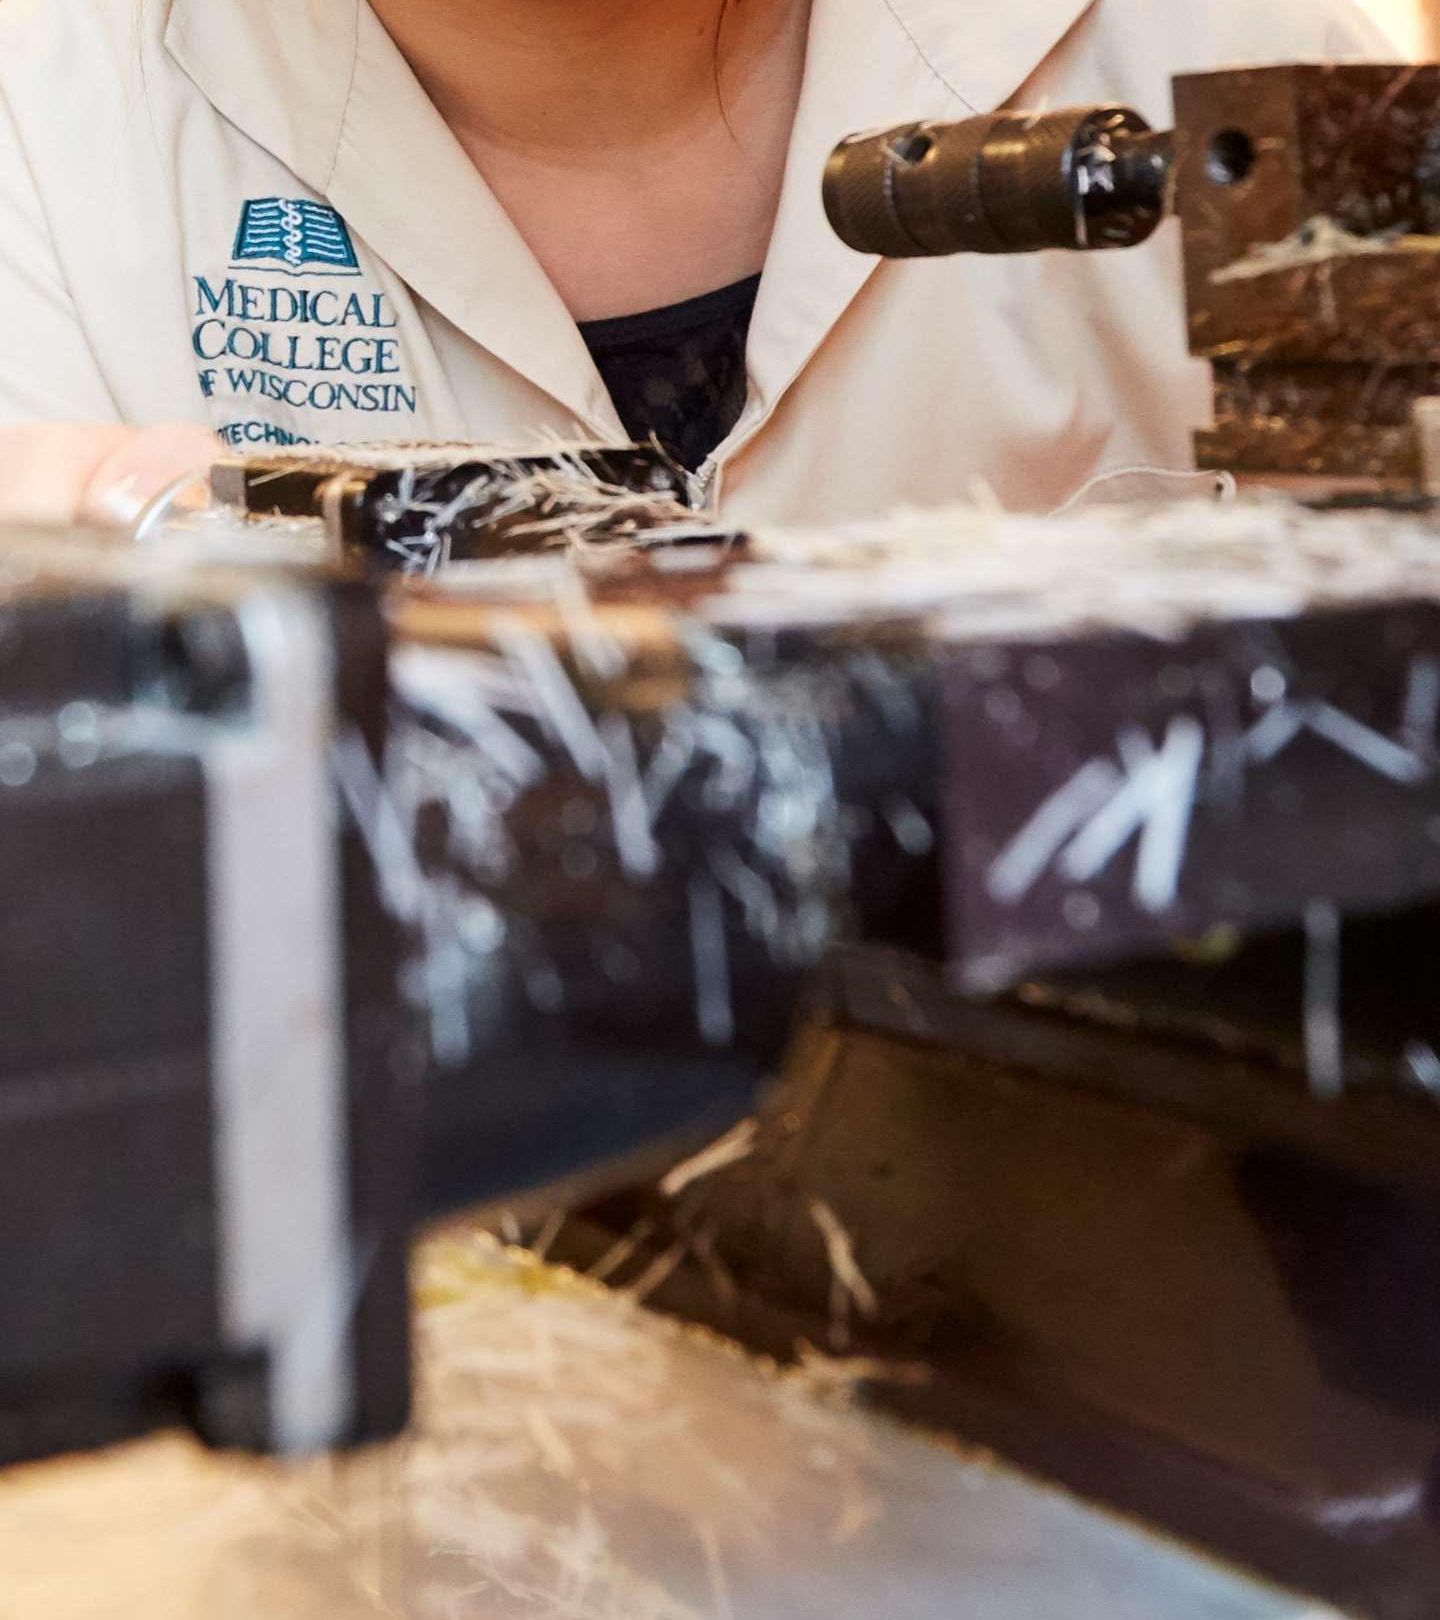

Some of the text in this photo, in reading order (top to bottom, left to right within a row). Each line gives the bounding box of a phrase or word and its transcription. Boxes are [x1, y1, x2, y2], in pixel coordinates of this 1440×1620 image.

[193, 275, 397, 328] MEDICAL
[192, 318, 400, 374] COLLEGE
[224, 367, 417, 413] WISCONSIN
